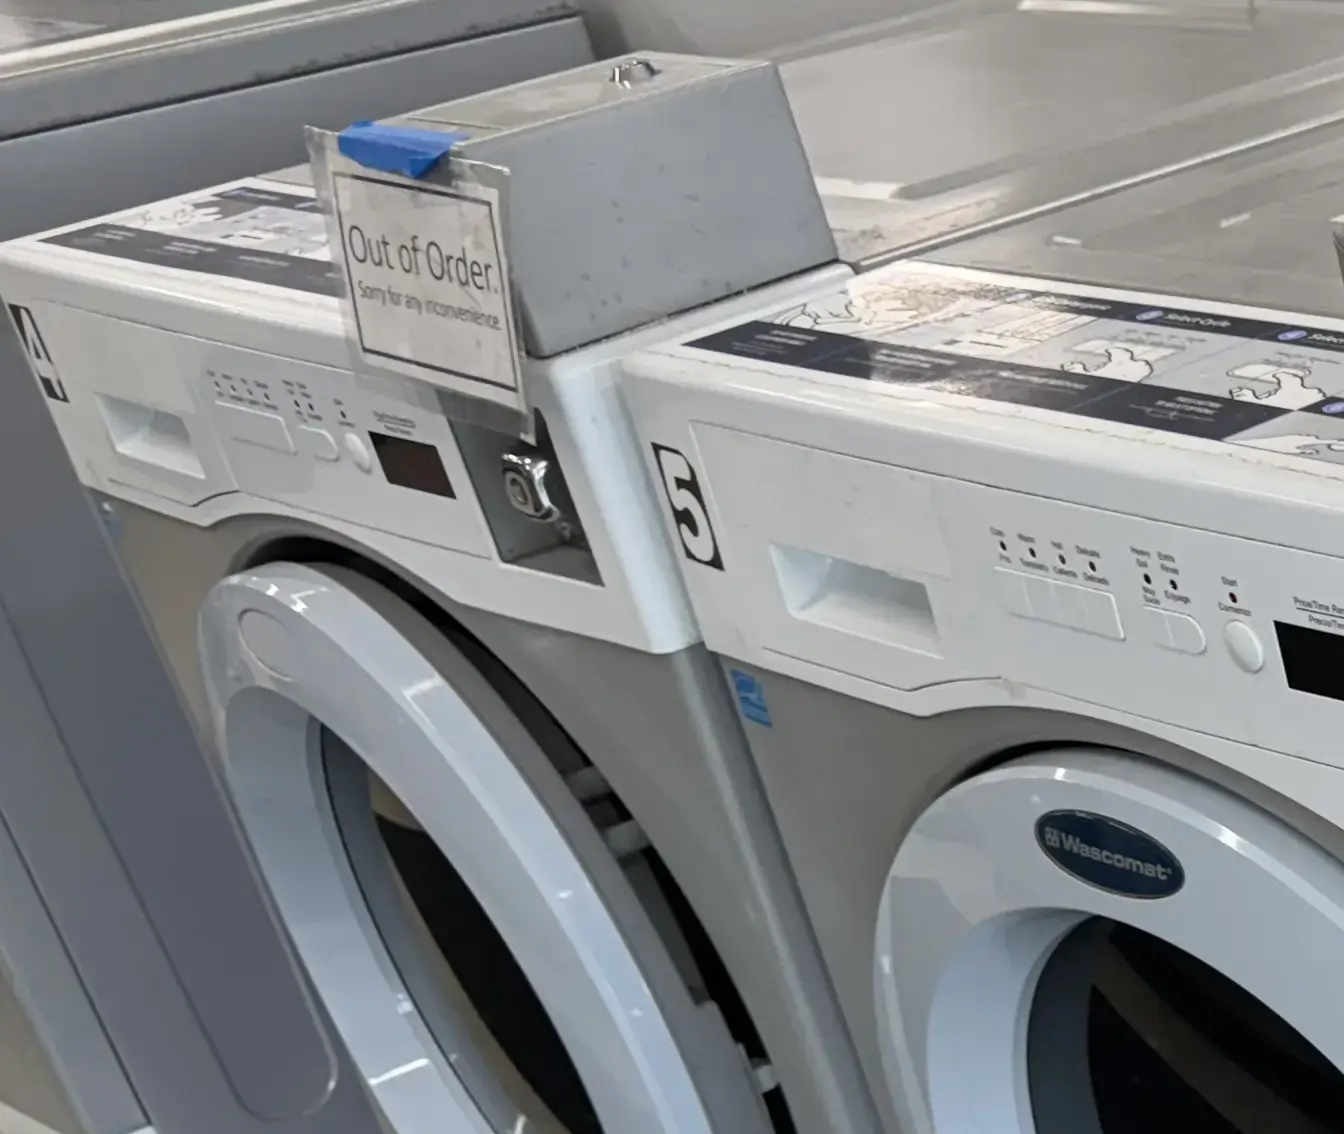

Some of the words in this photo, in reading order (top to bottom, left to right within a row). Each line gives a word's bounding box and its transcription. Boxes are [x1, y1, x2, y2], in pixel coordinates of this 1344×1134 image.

[349, 225, 395, 270] Out
[398, 235, 421, 276] of
[426, 241, 499, 295] Order.
[358, 280, 387, 306] Sorry
[387, 286, 403, 306] for
[404, 292, 422, 315] any
[654, 444, 720, 568] 5
